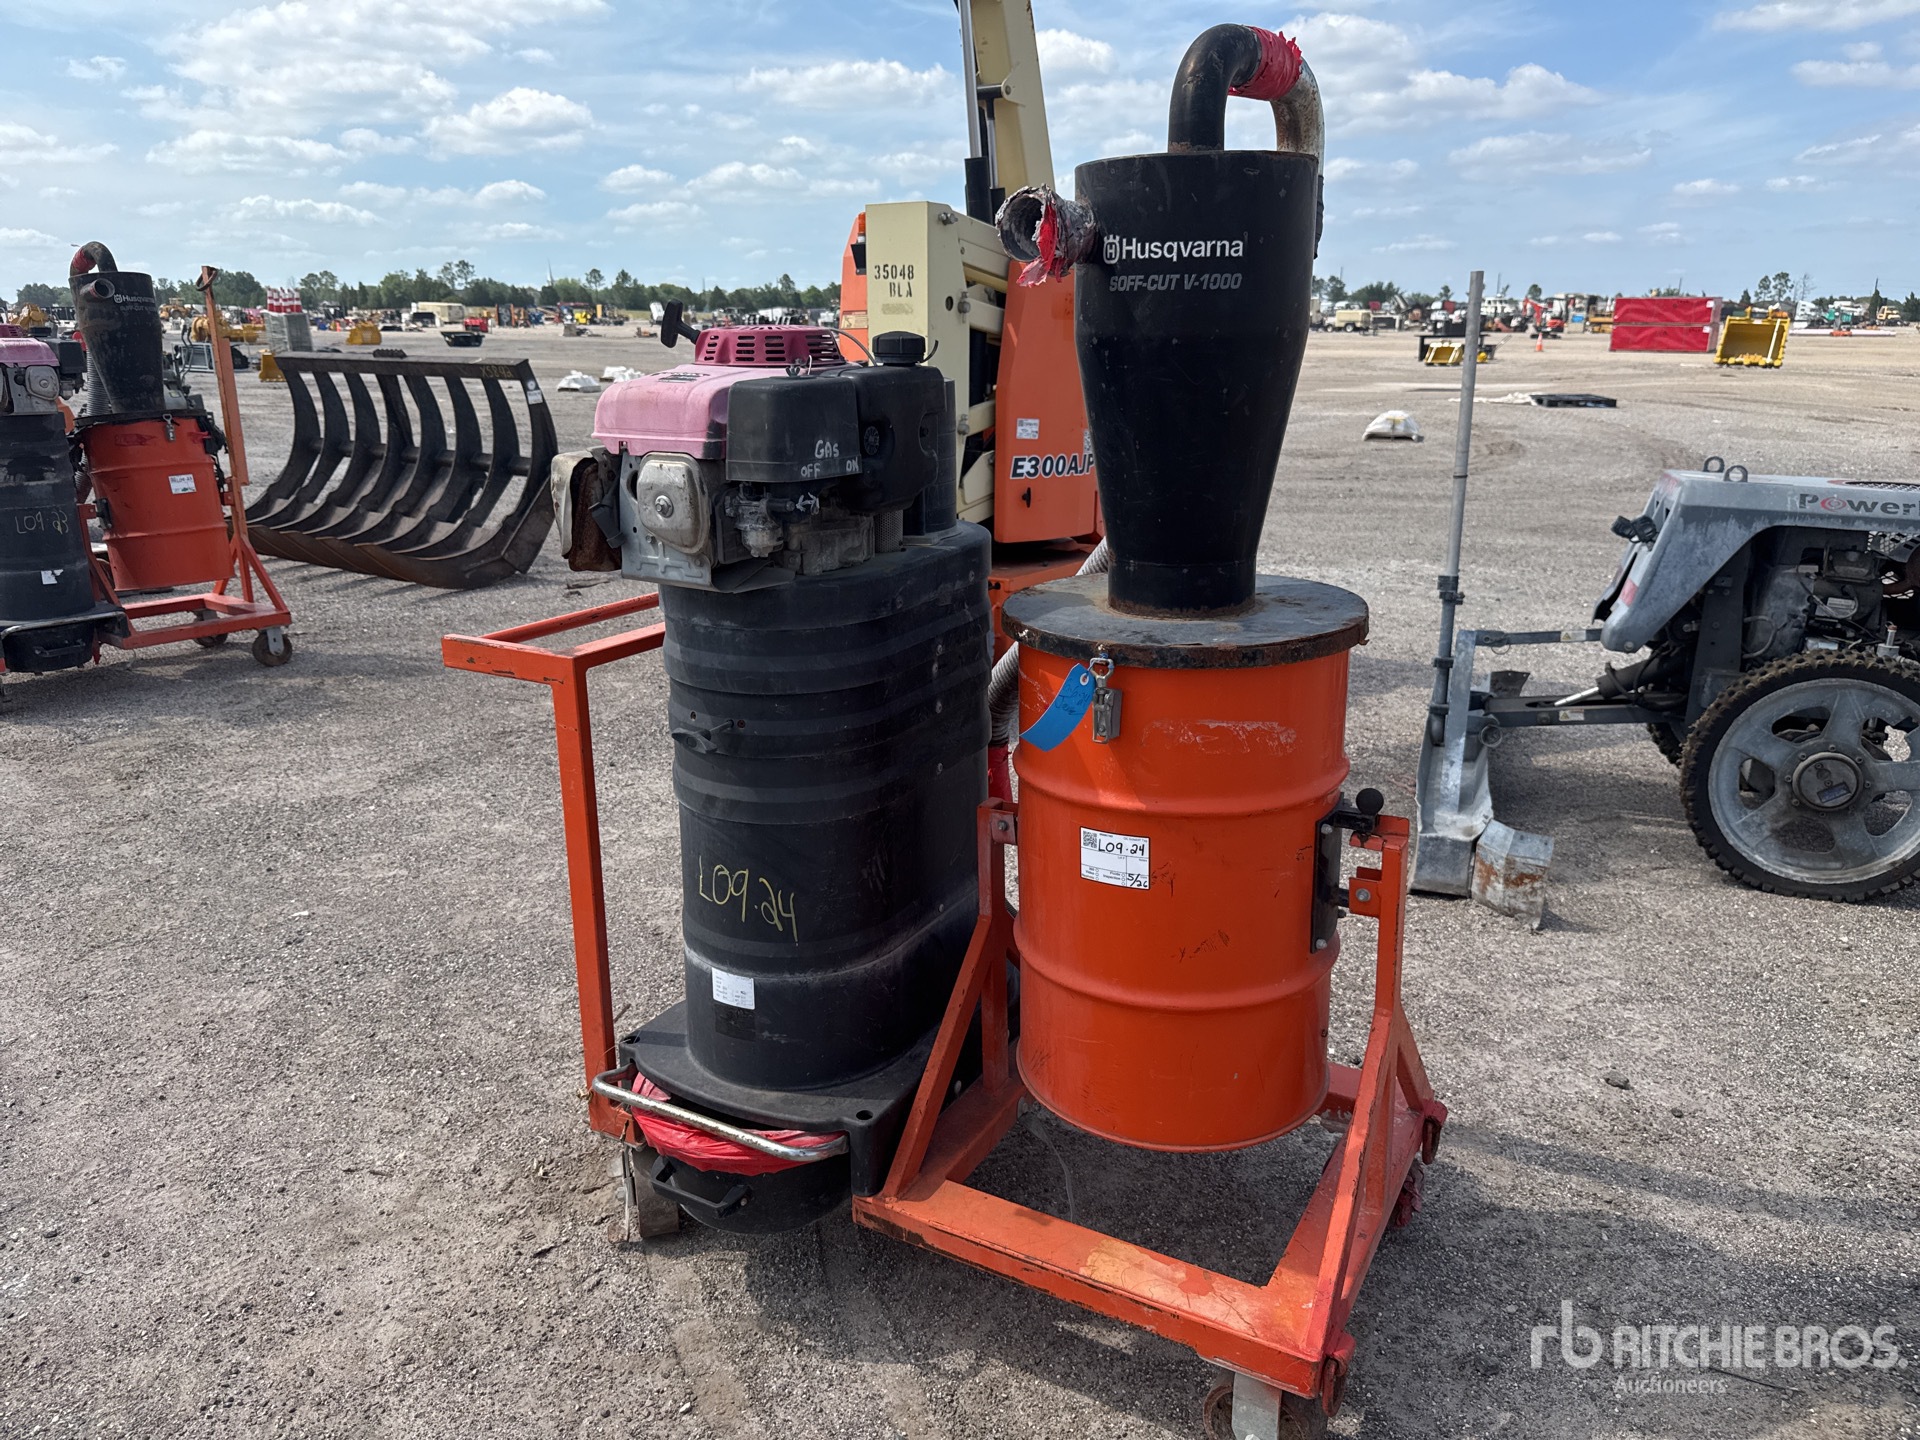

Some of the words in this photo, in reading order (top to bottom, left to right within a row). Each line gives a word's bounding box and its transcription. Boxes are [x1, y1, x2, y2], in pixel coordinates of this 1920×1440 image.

[1122, 237, 1243, 262] Husqvarna
[874, 264, 914, 280] 35048
[1109, 274, 1180, 291] SOFF-CUT
[1183, 273, 1242, 290] V-1000
[889, 281, 912, 298] BLA
[814, 439, 840, 459] GAS
[800, 462, 821, 479] OFF
[846, 456, 859, 473] ON
[1010, 453, 1095, 479] E300AJP
[1799, 493, 1920, 516] Power
